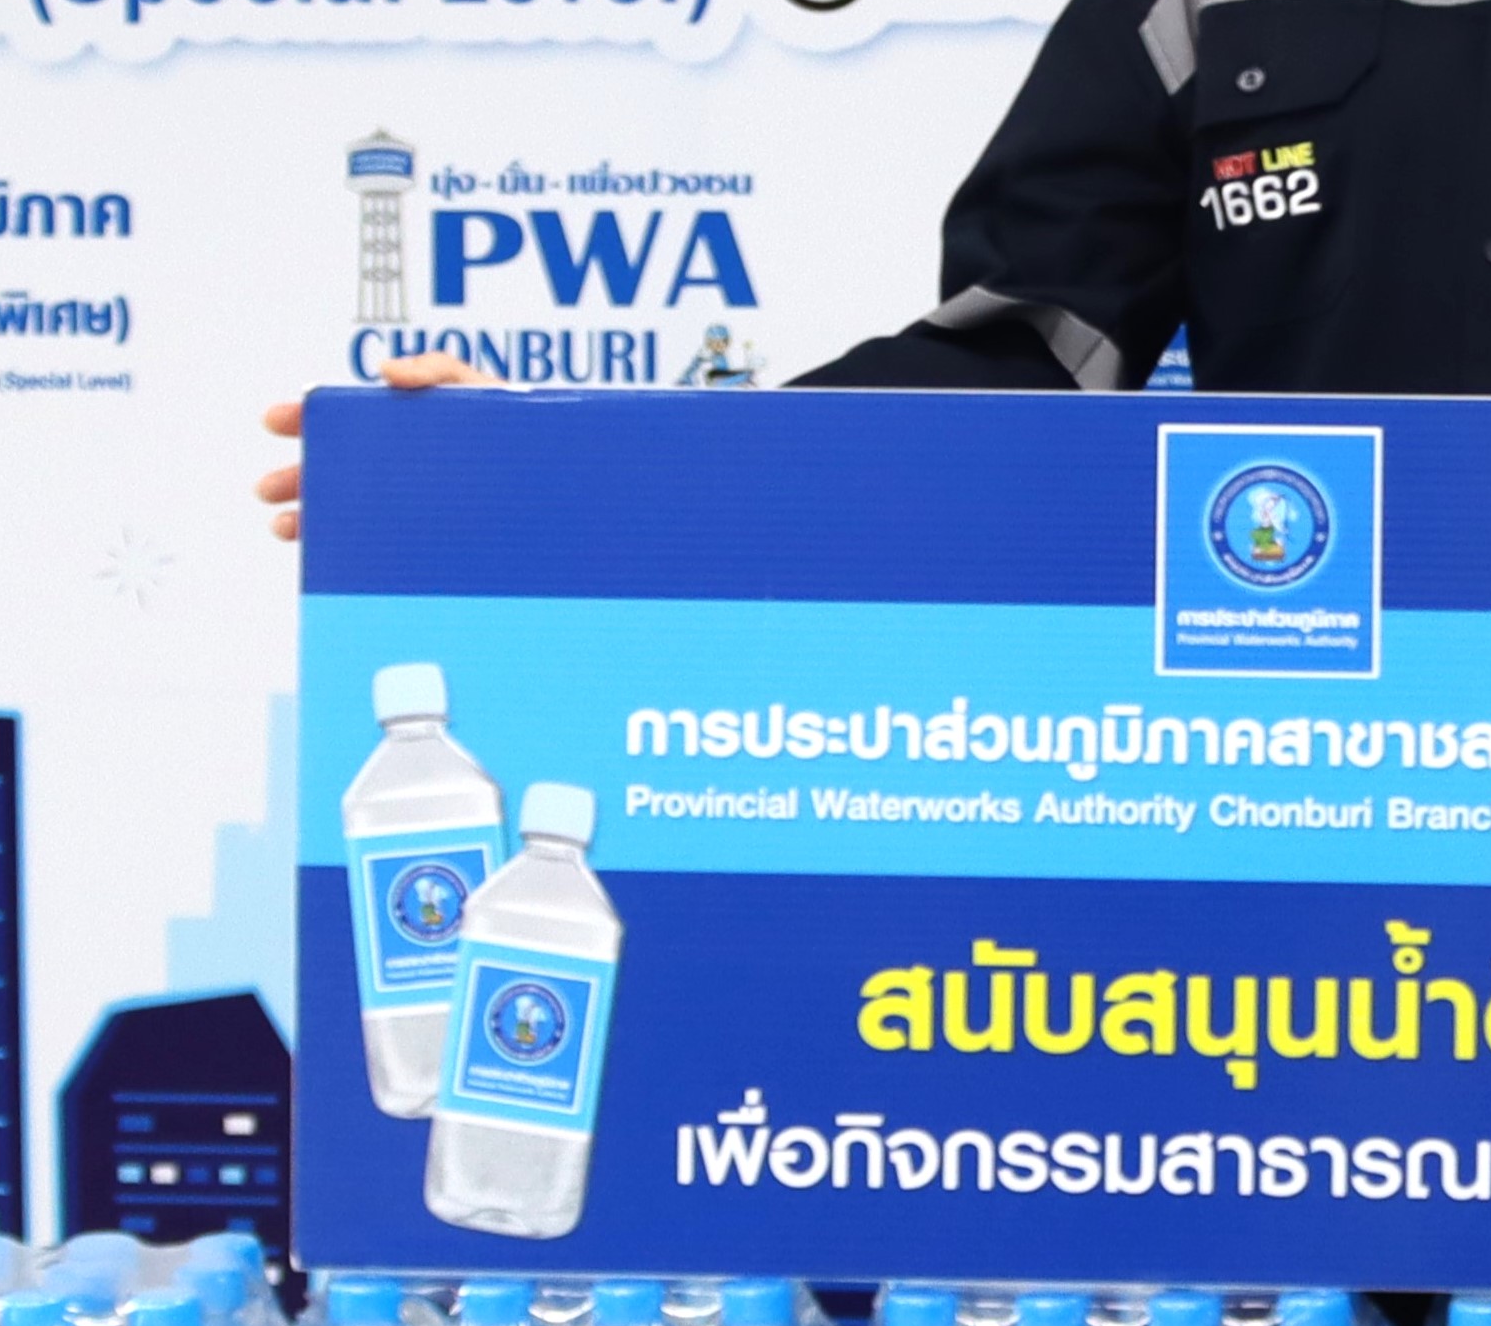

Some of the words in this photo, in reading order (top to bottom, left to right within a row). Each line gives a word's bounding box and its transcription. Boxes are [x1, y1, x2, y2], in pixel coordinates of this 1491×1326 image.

[1213, 151, 1256, 180] HOT
[1261, 141, 1315, 172] LINE
[1199, 168, 1322, 231] 1662
[432, 210, 759, 308] PWA
[626, 784, 795, 822] Provincial
[813, 788, 1018, 824] Waterworks
[1034, 792, 1195, 835] Authority
[1210, 796, 1373, 829] Chonburi
